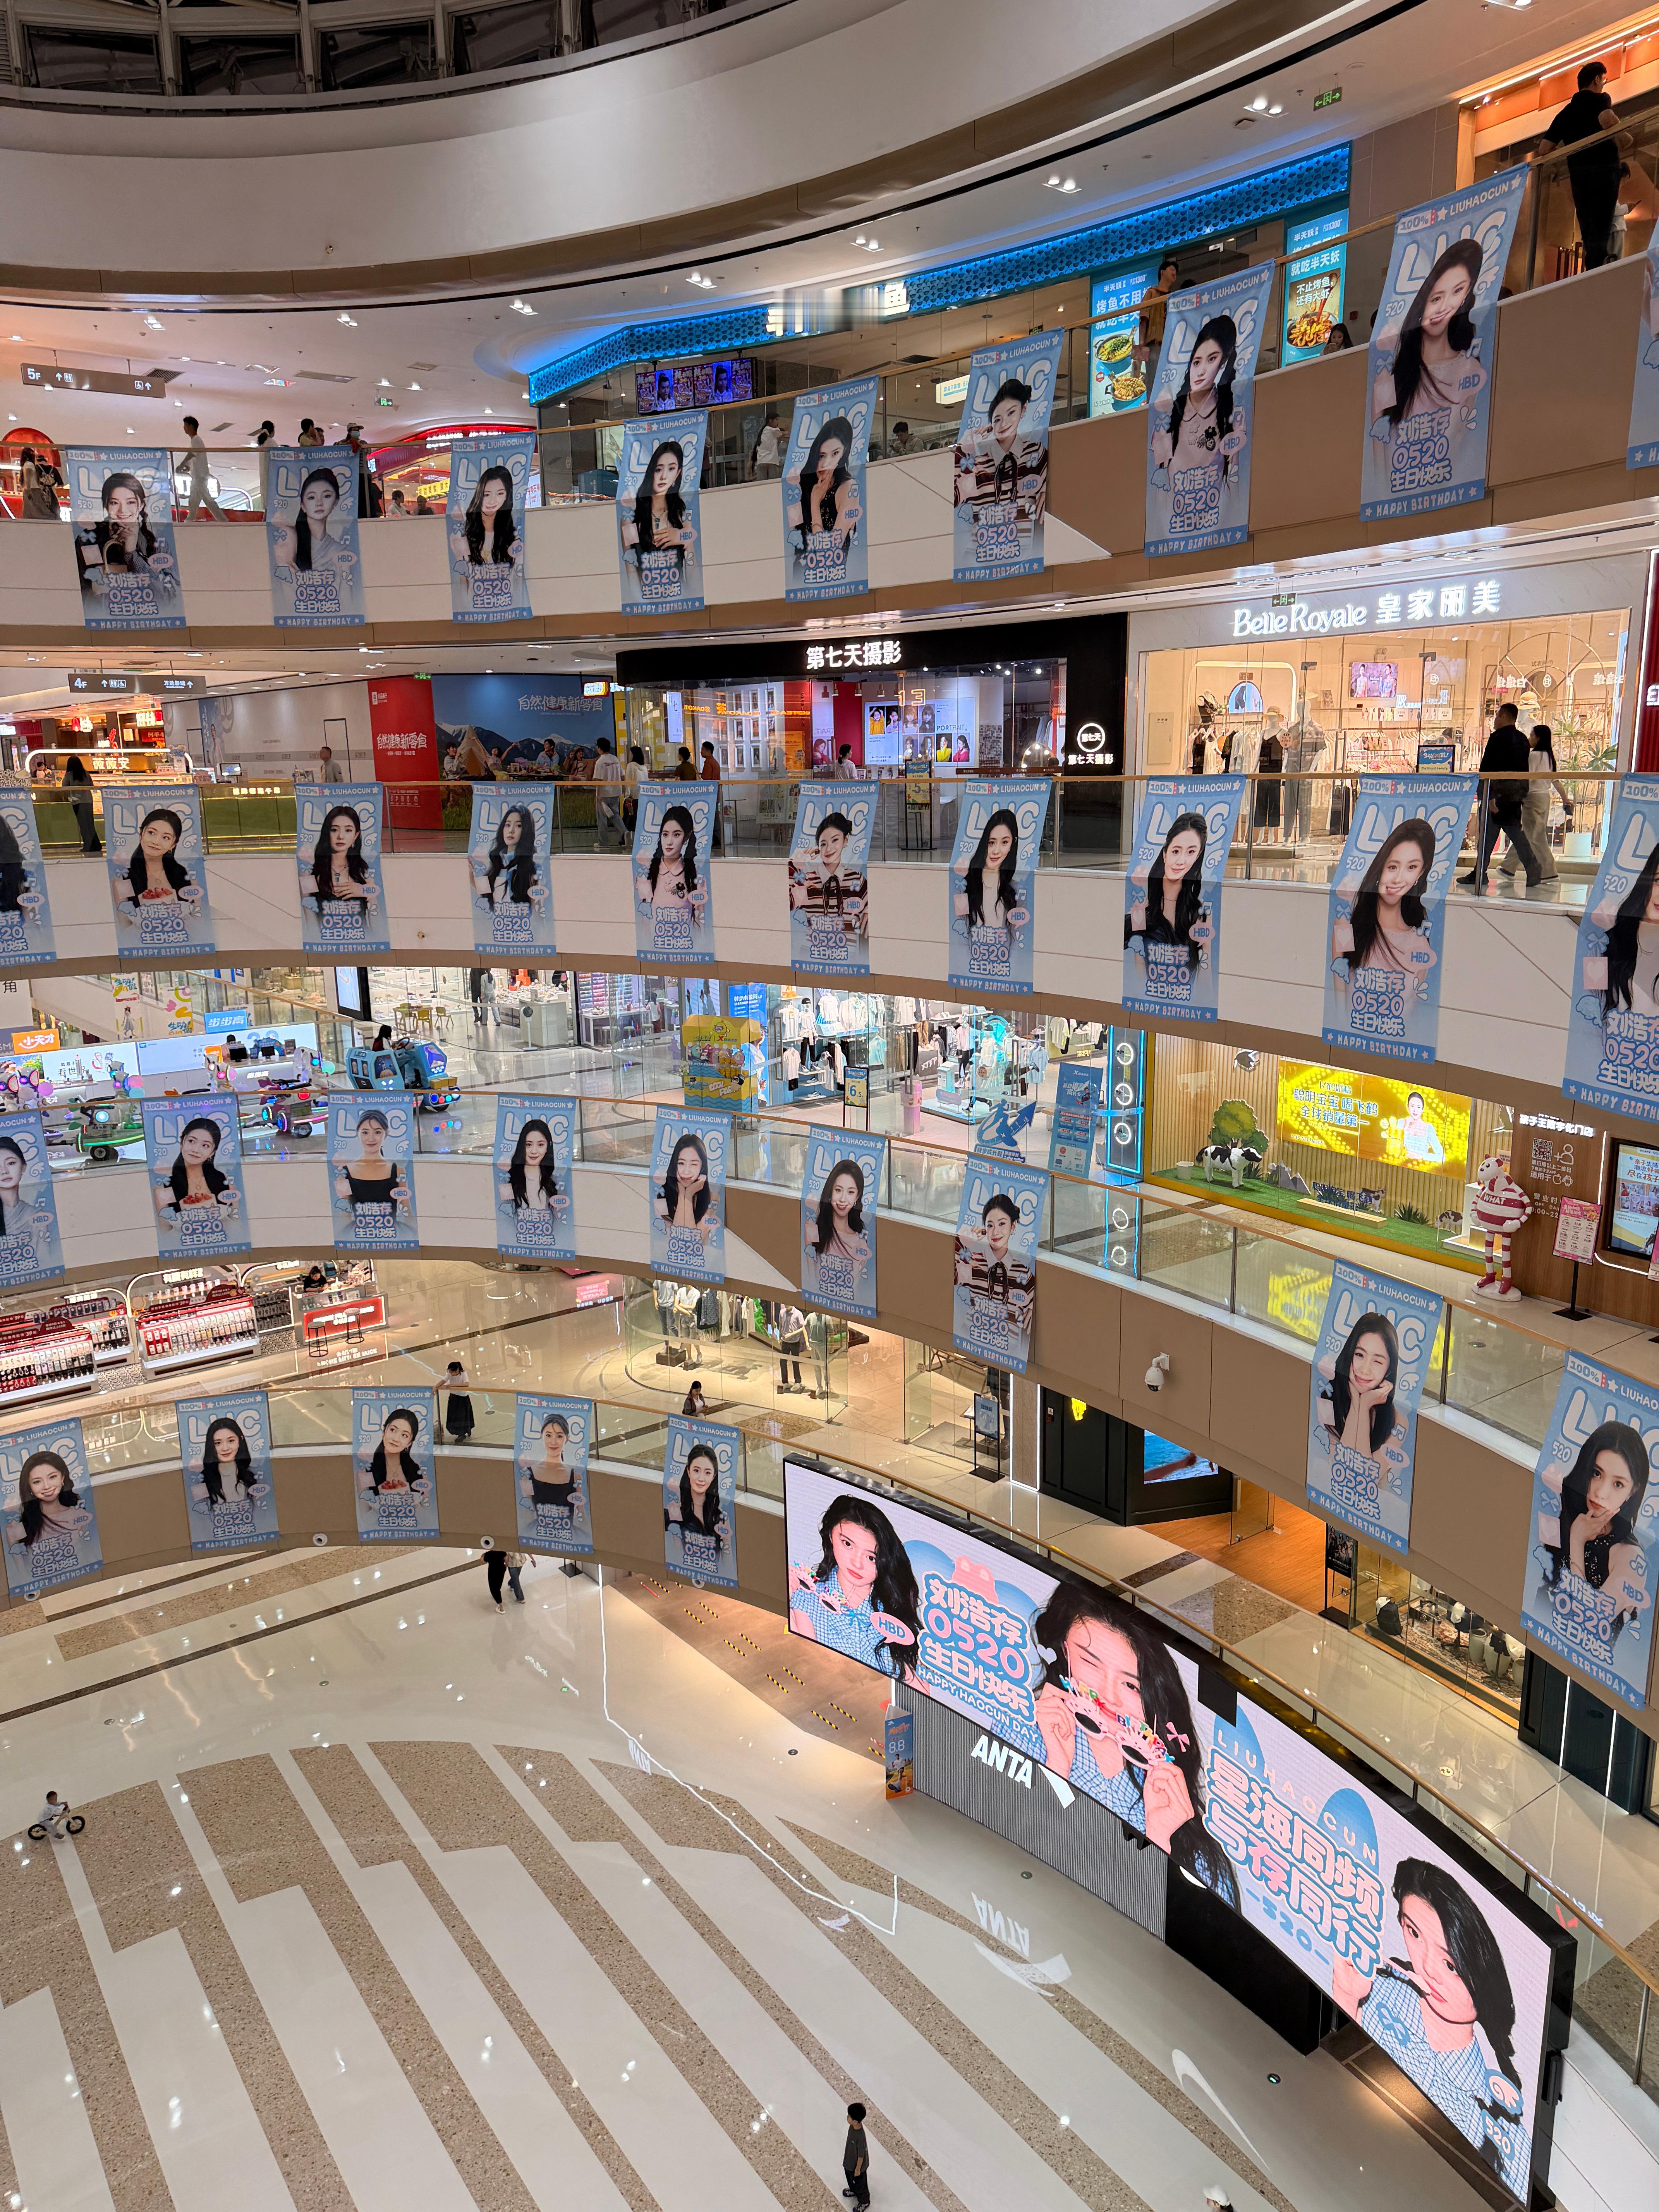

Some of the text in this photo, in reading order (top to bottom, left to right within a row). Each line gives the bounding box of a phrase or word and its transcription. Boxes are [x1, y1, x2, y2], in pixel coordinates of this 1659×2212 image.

[1449, 179, 1509, 217] LIUHAOCUN
[1291, 250, 1340, 276] 就吃半天妖
[1096, 287, 1151, 314] 烤鱼不用
[1385, 298, 1405, 318] 520
[1009, 338, 1050, 358] LIUHAOCUN
[27, 368, 41, 380] 5F
[1458, 372, 1480, 392] HBD
[830, 383, 867, 400] LIUHAOCUN
[1396, 405, 1453, 447] 刘浩存
[792, 451, 804, 462] 520
[1391, 433, 1451, 472] 0520
[1389, 459, 1451, 495] 生日快乐
[1171, 485, 1219, 515] 0520
[1376, 486, 1465, 518] HAPPY BIRTHDAY
[680, 531, 693, 540] HBD
[1187, 530, 1231, 550] BIRTHDAY
[474, 562, 511, 580] 刘浩存
[642, 567, 678, 585] 0520
[965, 568, 989, 580] HAPPY
[296, 585, 336, 600] 0520
[473, 578, 511, 595] 0520
[297, 600, 339, 613] 生日快乐
[1376, 582, 1500, 624] 皇家丽美
[101, 619, 171, 629] HAPPY BIRTHDAY
[1233, 603, 1367, 637] Belle Royale
[806, 640, 902, 670] 第七天摄影
[74, 678, 87, 688] 4F
[518, 695, 603, 712] 自然健康新零食
[143, 789, 185, 797] LIUHAOCUN
[833, 785, 868, 794] LIUHAOCUN
[1186, 782, 1226, 793] LIUHAOCUN
[1408, 781, 1461, 793] LIUHAOCUN
[299, 833, 314, 842] 520
[1138, 848, 1154, 859] 520
[1345, 856, 1365, 870] 520
[655, 922, 690, 936] 0520
[656, 937, 692, 949] 生日快乐
[810, 931, 845, 946] 0520
[969, 943, 1008, 961] 0520
[1410, 951, 1430, 964] HBD
[984, 981, 1020, 993] BIRTHDAY
[1355, 967, 1406, 995] 刘浩存
[1351, 989, 1404, 1017] 0520
[208, 1016, 245, 1027] 步步高
[1350, 1012, 1405, 1037] 生日快乐
[23, 1033, 55, 1046] 小天才
[1337, 1034, 1418, 1059] HAPPY BIRTHDAY
[921, 1056, 938, 1071] XTEP
[183, 1098, 223, 1108] LIUHAOCUN
[1293, 1088, 1378, 1116] 聪明宝宝 喝飞鹤
[689, 1114, 721, 1123] LIUHAOCUN
[1300, 1104, 1369, 1127] 全球销量第一
[1519, 1114, 1594, 1138] 孩子王数字化门店
[1001, 1169, 1037, 1183] LIUHAOCUN
[1530, 1171, 1551, 1181] 适用于
[1484, 1194, 1506, 1205] WHAT
[1534, 1192, 1559, 1204] 营业时
[517, 1208, 552, 1222] 刘浩存
[516, 1221, 552, 1235] 0520
[183, 1231, 225, 1246] 生日快乐
[856, 1247, 868, 1257] HBD
[819, 1267, 853, 1287] 0520
[1378, 1283, 1427, 1309] LIUHAOCUN
[962, 1341, 983, 1355] HAPPY
[1325, 1336, 1341, 1352] 520
[519, 1441, 532, 1449] 520
[1552, 1440, 1570, 1463] 520
[1335, 1442, 1381, 1483] 刘浩存
[1384, 1448, 1405, 1464] HBD
[1331, 1461, 1379, 1502] 0520
[1330, 1480, 1380, 1520] 生日快乐
[74, 1514, 88, 1525] HBD
[378, 1506, 414, 1516] 0520
[537, 1504, 571, 1518] 刘浩存
[1319, 1496, 1392, 1544] HAPPY BIRTHDAY
[380, 1517, 417, 1527] 生日快乐
[206, 1534, 267, 1549] HAPPY BIRTHDAY
[675, 1567, 727, 1586] HAPPY BIRTHDAY
[1621, 1582, 1645, 1604] HBD
[929, 1578, 1024, 1645] 刘浩存
[1553, 1589, 1614, 1645] 0520
[878, 1616, 906, 1639] HBD
[927, 1608, 1025, 1679] 0520
[924, 1637, 1030, 1717] 生日快乐
[1572, 1651, 1627, 1697] BIRTHDAY
[918, 1667, 1038, 1742] HAPPY HAOCUN DAY
[971, 1734, 1033, 1790] ANTA
[1218, 1729, 1376, 1866] LIUHAOCUN
[1210, 1753, 1380, 1927] 星海同频
[1208, 1801, 1376, 1973] 与存同行
[1486, 2120, 1511, 2154] 520
